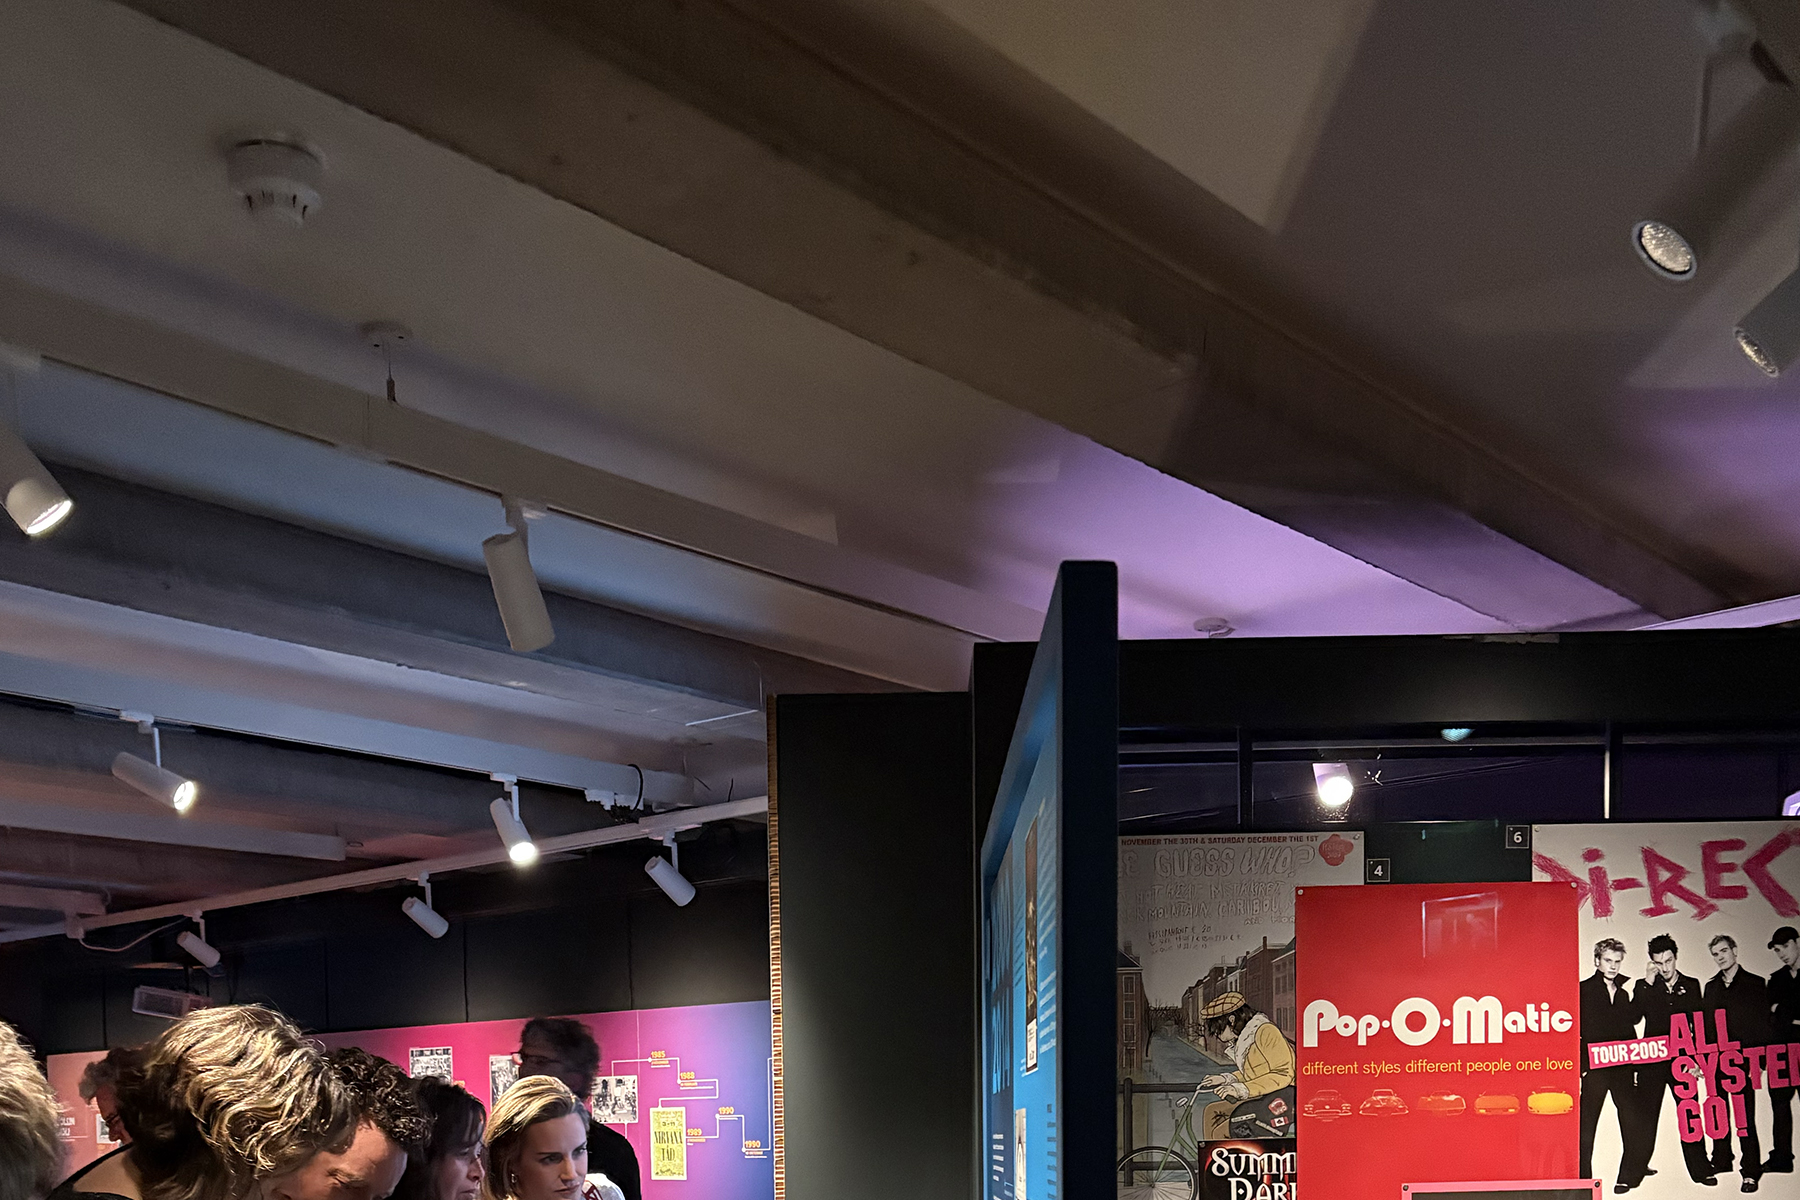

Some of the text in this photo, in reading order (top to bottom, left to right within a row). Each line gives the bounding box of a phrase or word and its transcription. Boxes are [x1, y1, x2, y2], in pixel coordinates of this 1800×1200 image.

[1121, 838, 1162, 846] NOVEMBER
[1163, 837, 1178, 846] THE
[1207, 836, 1245, 845] SATURDAY
[1248, 835, 1287, 844] DECEMBER
[1289, 835, 1303, 843] THE
[1306, 834, 1319, 843] 1ST
[1513, 831, 1523, 843] 6
[1154, 847, 1236, 878] GUESS
[1240, 845, 1316, 878] WHO?
[1373, 864, 1383, 877] 4
[1669, 1008, 1741, 1057] ALL
[1591, 1040, 1669, 1065] TOUR 2005
[1303, 1057, 1573, 1077] different styles different people one love
[1677, 1093, 1748, 1143] GO!
[654, 1131, 683, 1144] NIRVANA
